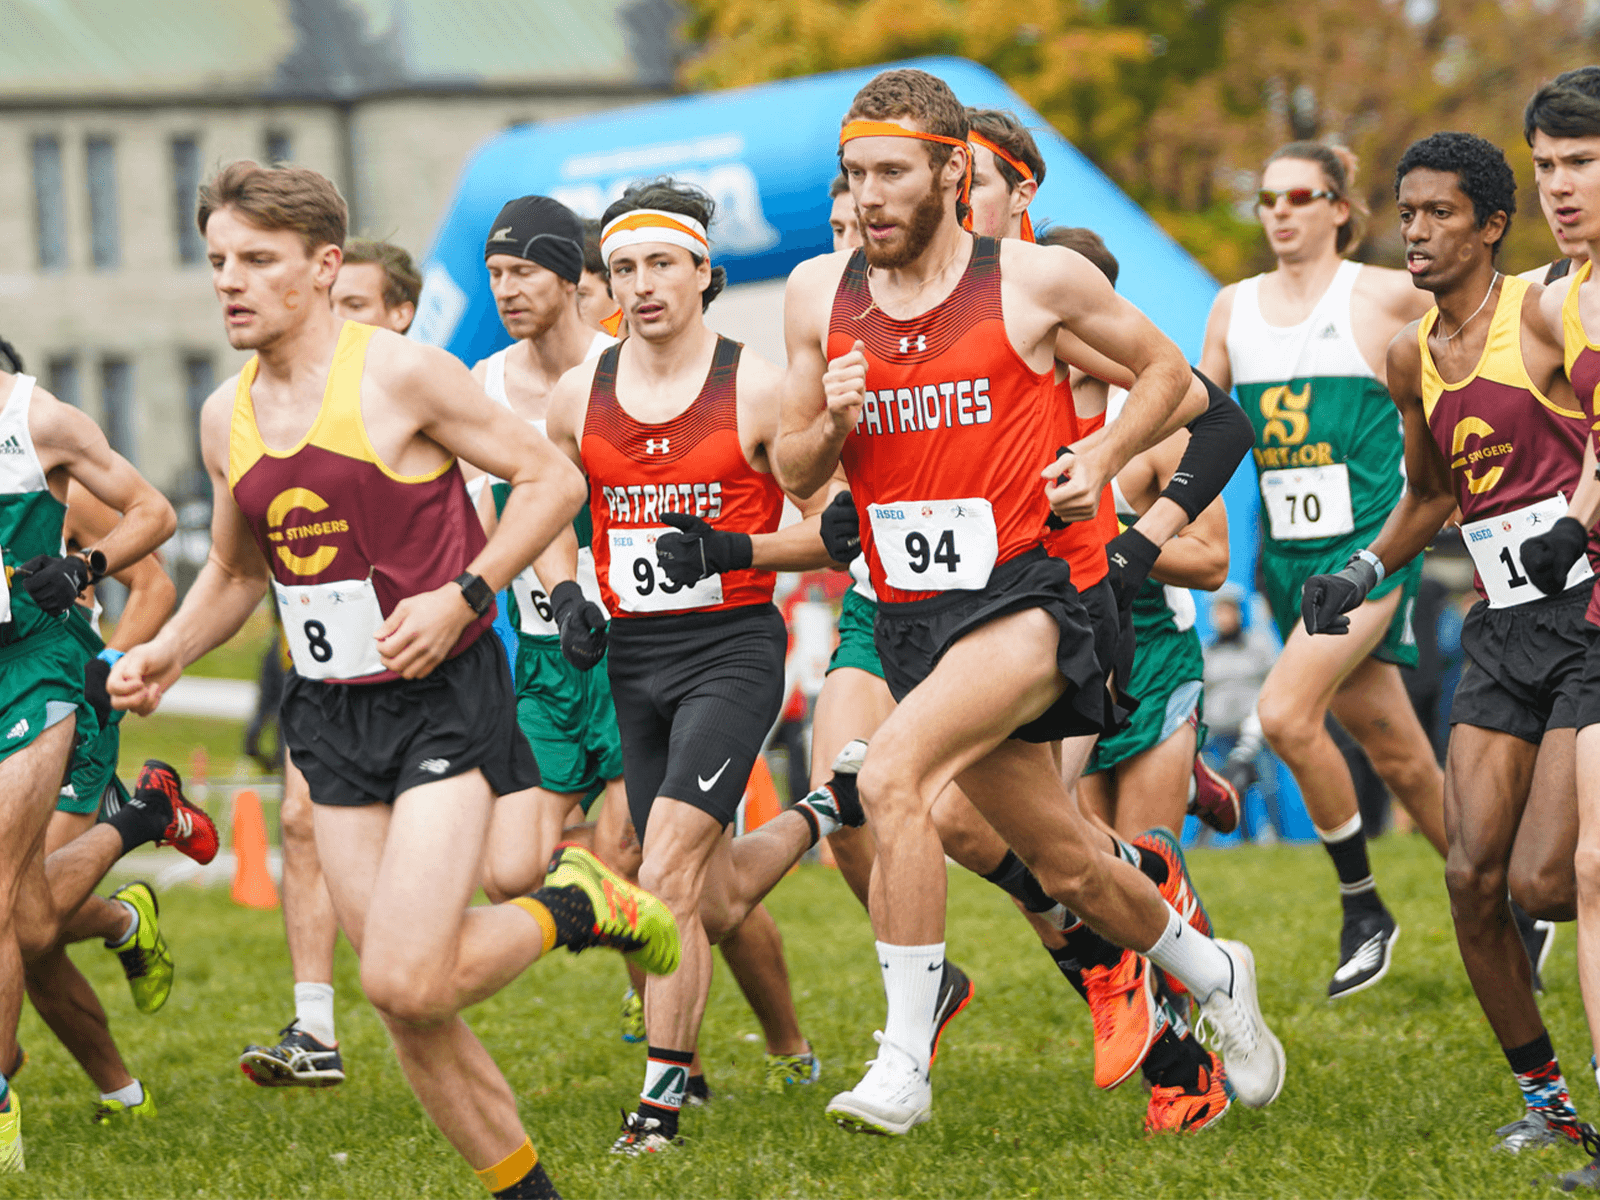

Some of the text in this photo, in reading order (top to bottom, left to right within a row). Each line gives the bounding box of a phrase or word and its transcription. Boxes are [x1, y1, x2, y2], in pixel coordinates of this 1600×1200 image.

[602, 481, 722, 523] PATRIOTES
[875, 508, 905, 520] RSEQ
[1285, 493, 1321, 524] 70
[285, 518, 349, 541] STINGERS
[905, 529, 961, 574] 94
[303, 619, 333, 663] 8
